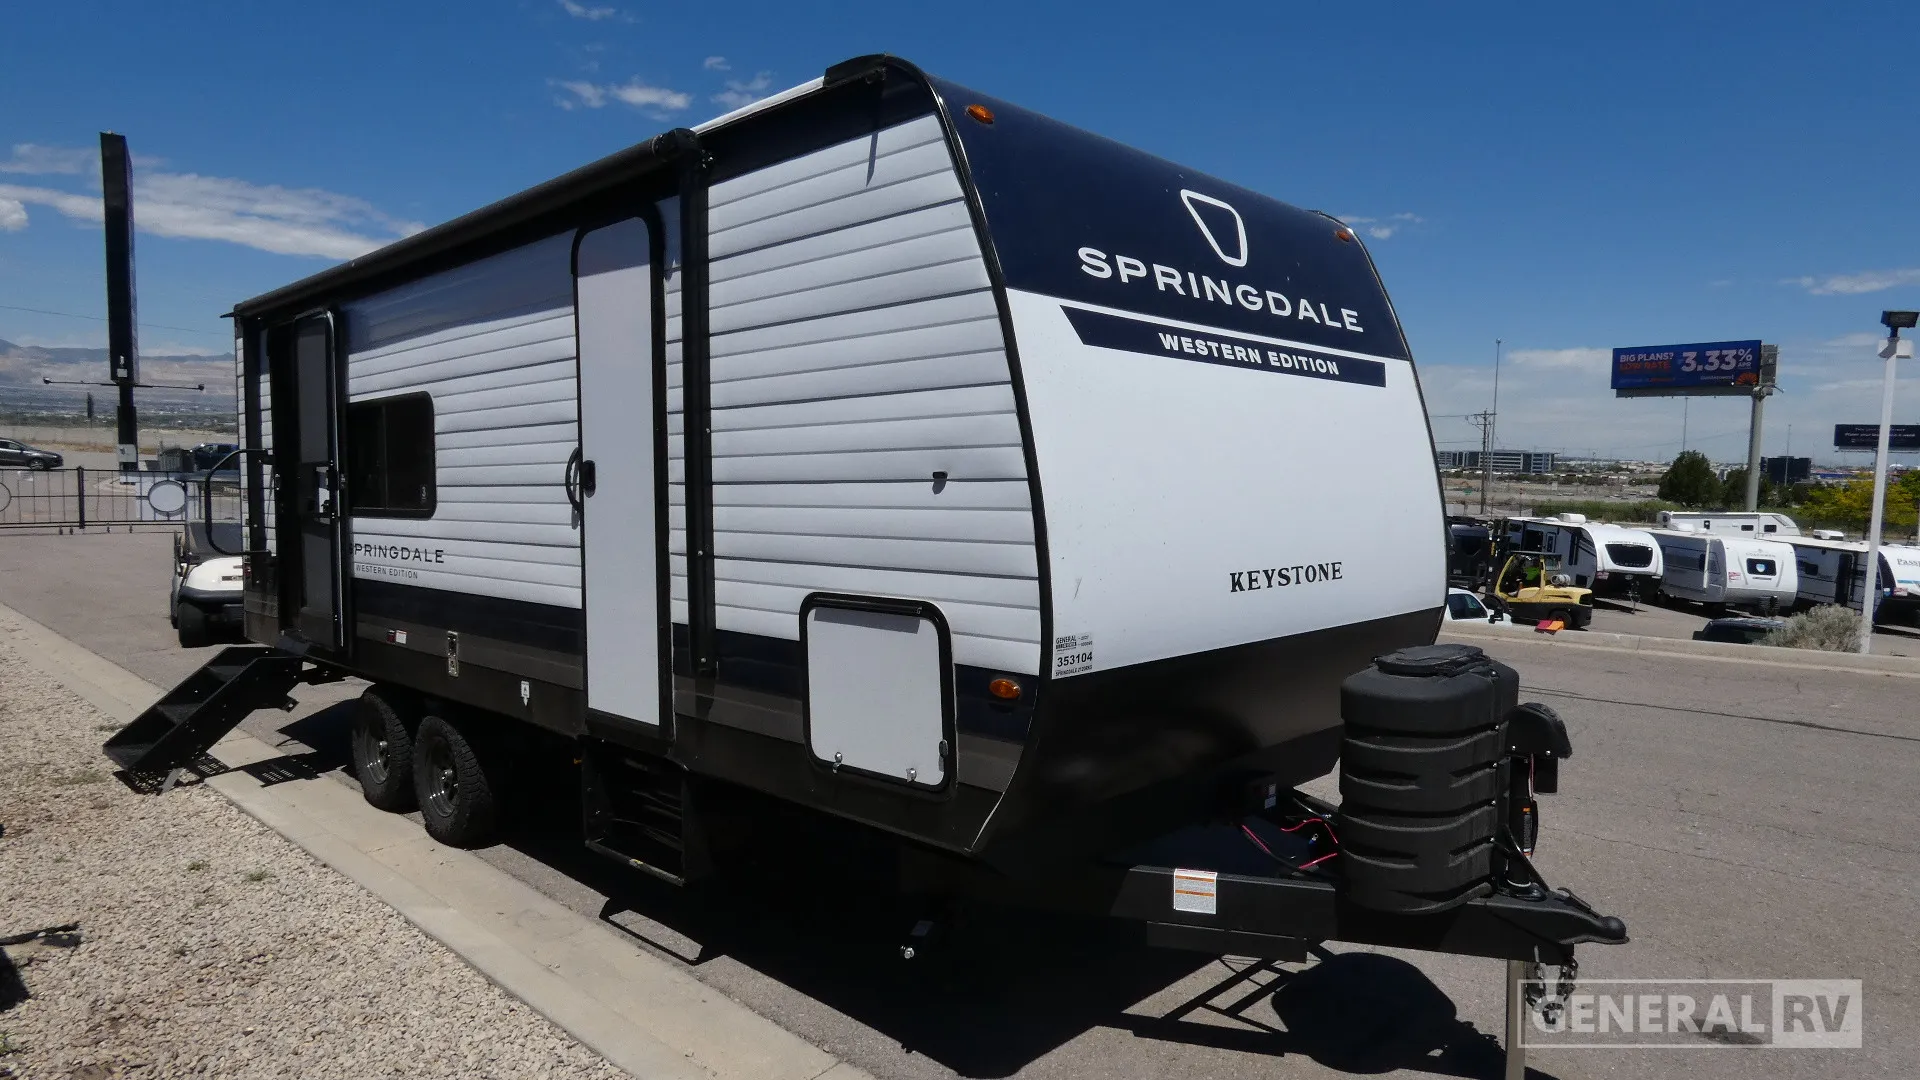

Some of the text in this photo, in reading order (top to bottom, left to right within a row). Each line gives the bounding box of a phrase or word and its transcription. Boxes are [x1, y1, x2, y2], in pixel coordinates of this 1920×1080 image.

[1077, 246, 1364, 333] SPRINGDALE
[1158, 332, 1340, 376] WESTERN EDITION
[1620, 352, 1675, 362] BIG PLANS?
[356, 564, 418, 579] WESTERN EDITION
[1229, 561, 1344, 593] KEYSTONE
[1056, 636, 1076, 644] GENERAL
[1057, 652, 1092, 668] 353104
